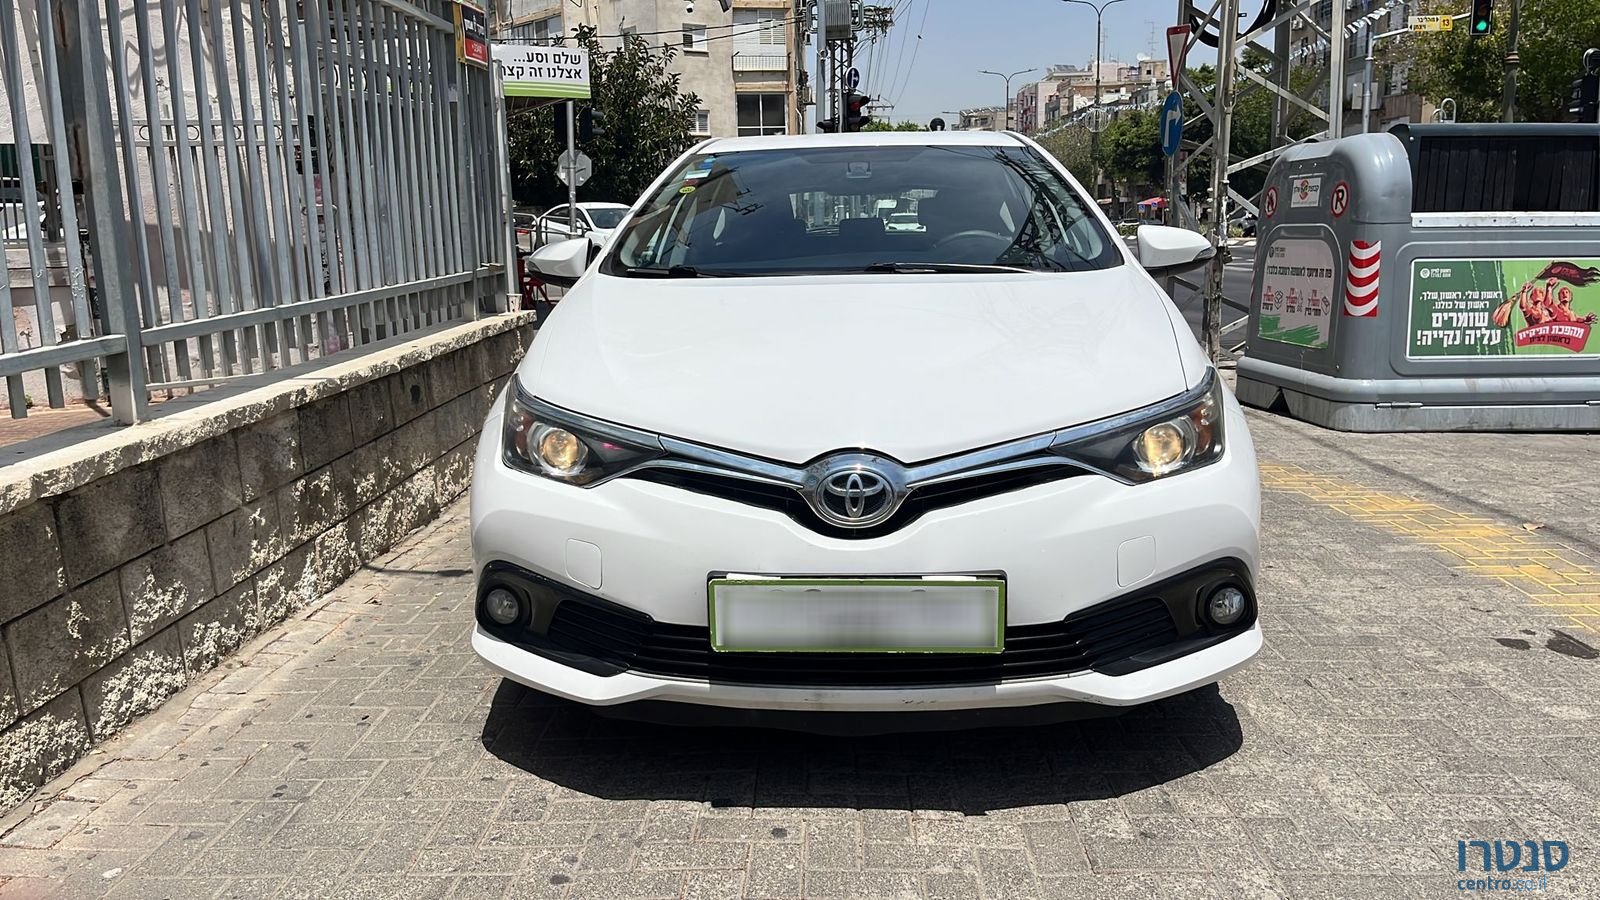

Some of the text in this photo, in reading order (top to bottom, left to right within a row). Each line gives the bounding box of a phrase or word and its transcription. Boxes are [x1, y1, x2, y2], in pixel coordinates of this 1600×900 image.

[513, 52, 549, 63] וסע...
[554, 51, 581, 64] שלם
[529, 67, 543, 77] זה
[547, 65, 582, 79] אצלנו
[1439, 291, 1462, 301] ראשון
[1481, 291, 1503, 300] ראשון
[1454, 300, 1466, 309] של
[1467, 300, 1490, 310] ראשון
[1432, 311, 1489, 328] שומרים
[1416, 327, 1502, 348] עליה נקייה!
[1518, 325, 1585, 340] מהפכת הניקיון
